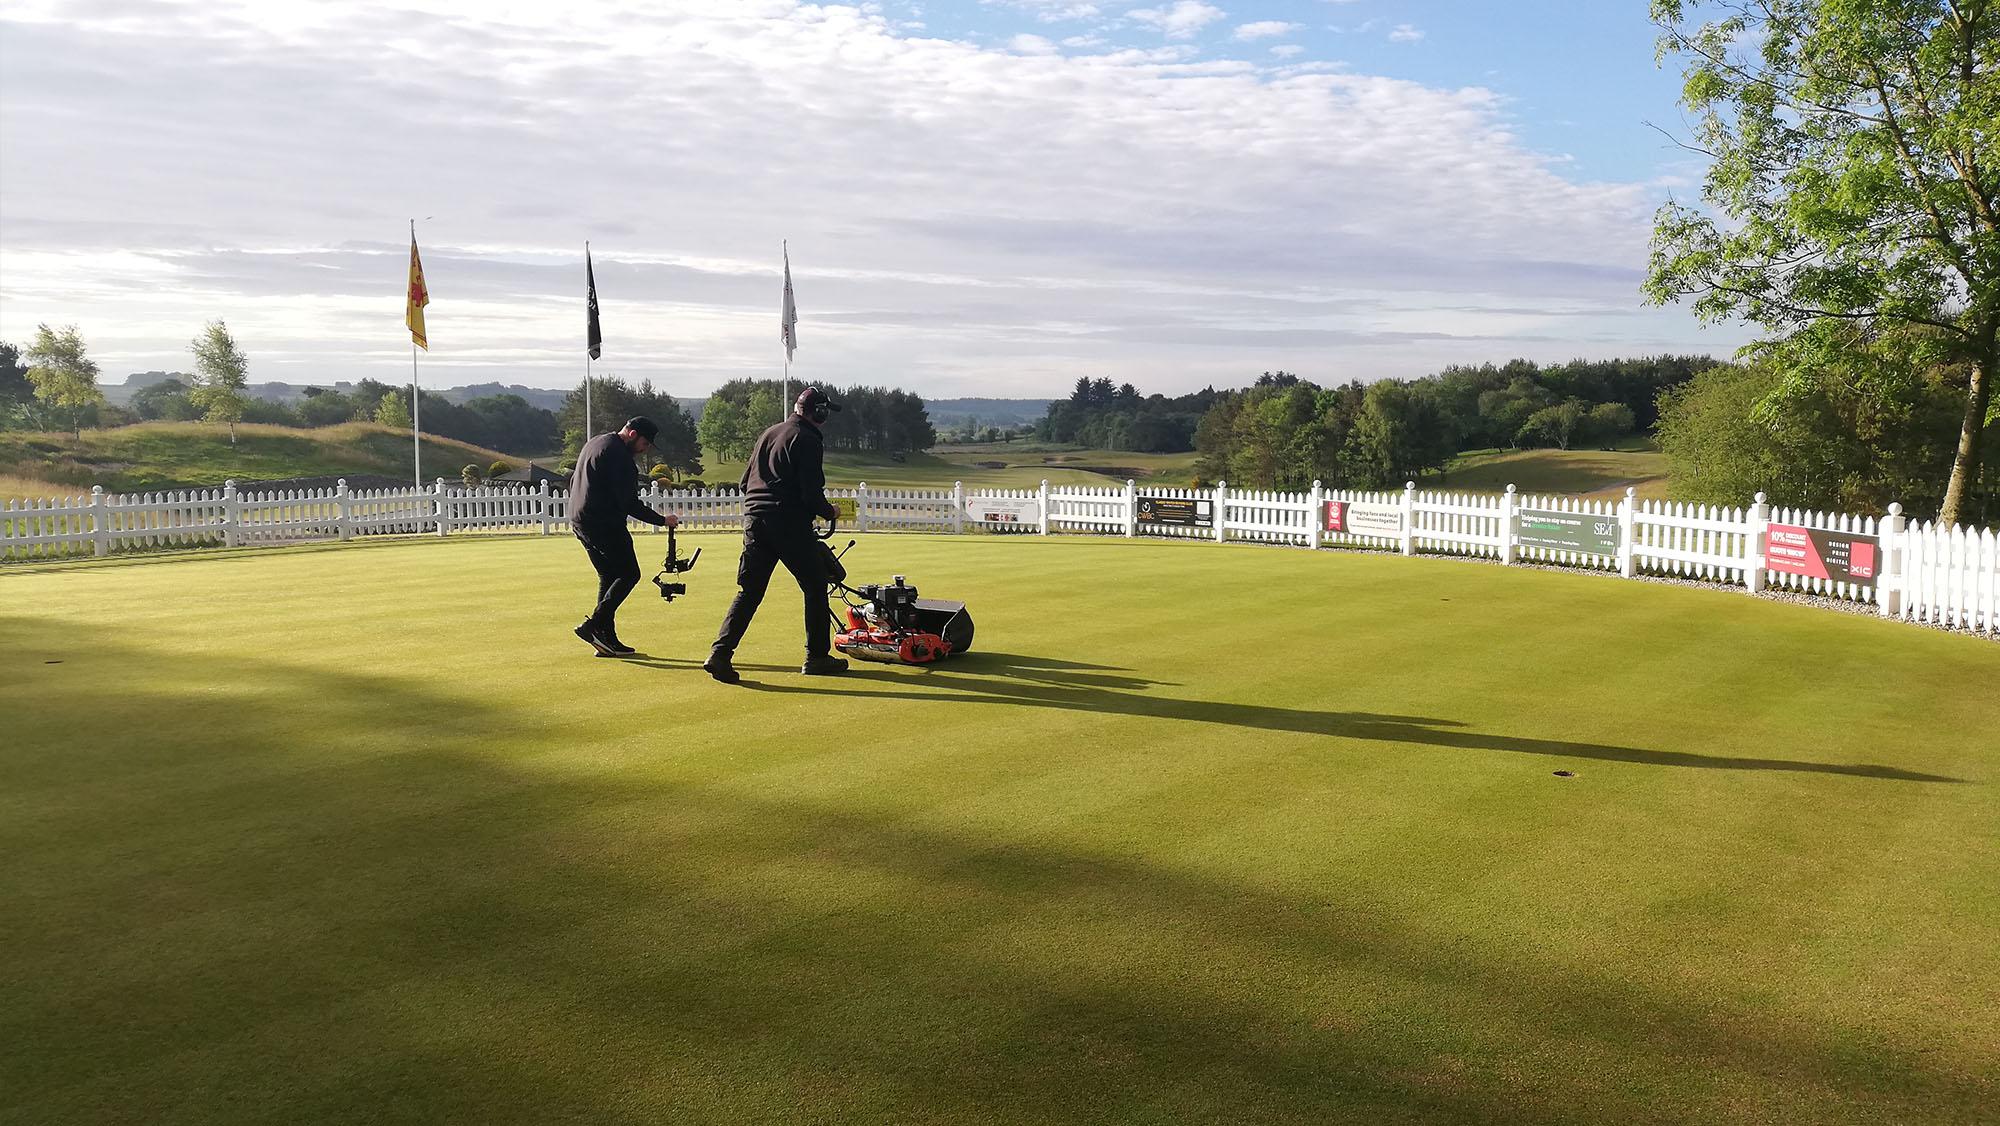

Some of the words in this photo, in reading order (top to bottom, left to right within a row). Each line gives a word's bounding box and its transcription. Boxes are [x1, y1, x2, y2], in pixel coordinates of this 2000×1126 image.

[1771, 531, 1785, 542] 10%
[1828, 541, 1849, 549] DESIGN
[1826, 557, 1848, 565] DIGITAL
[1851, 565, 1871, 575] XIC
